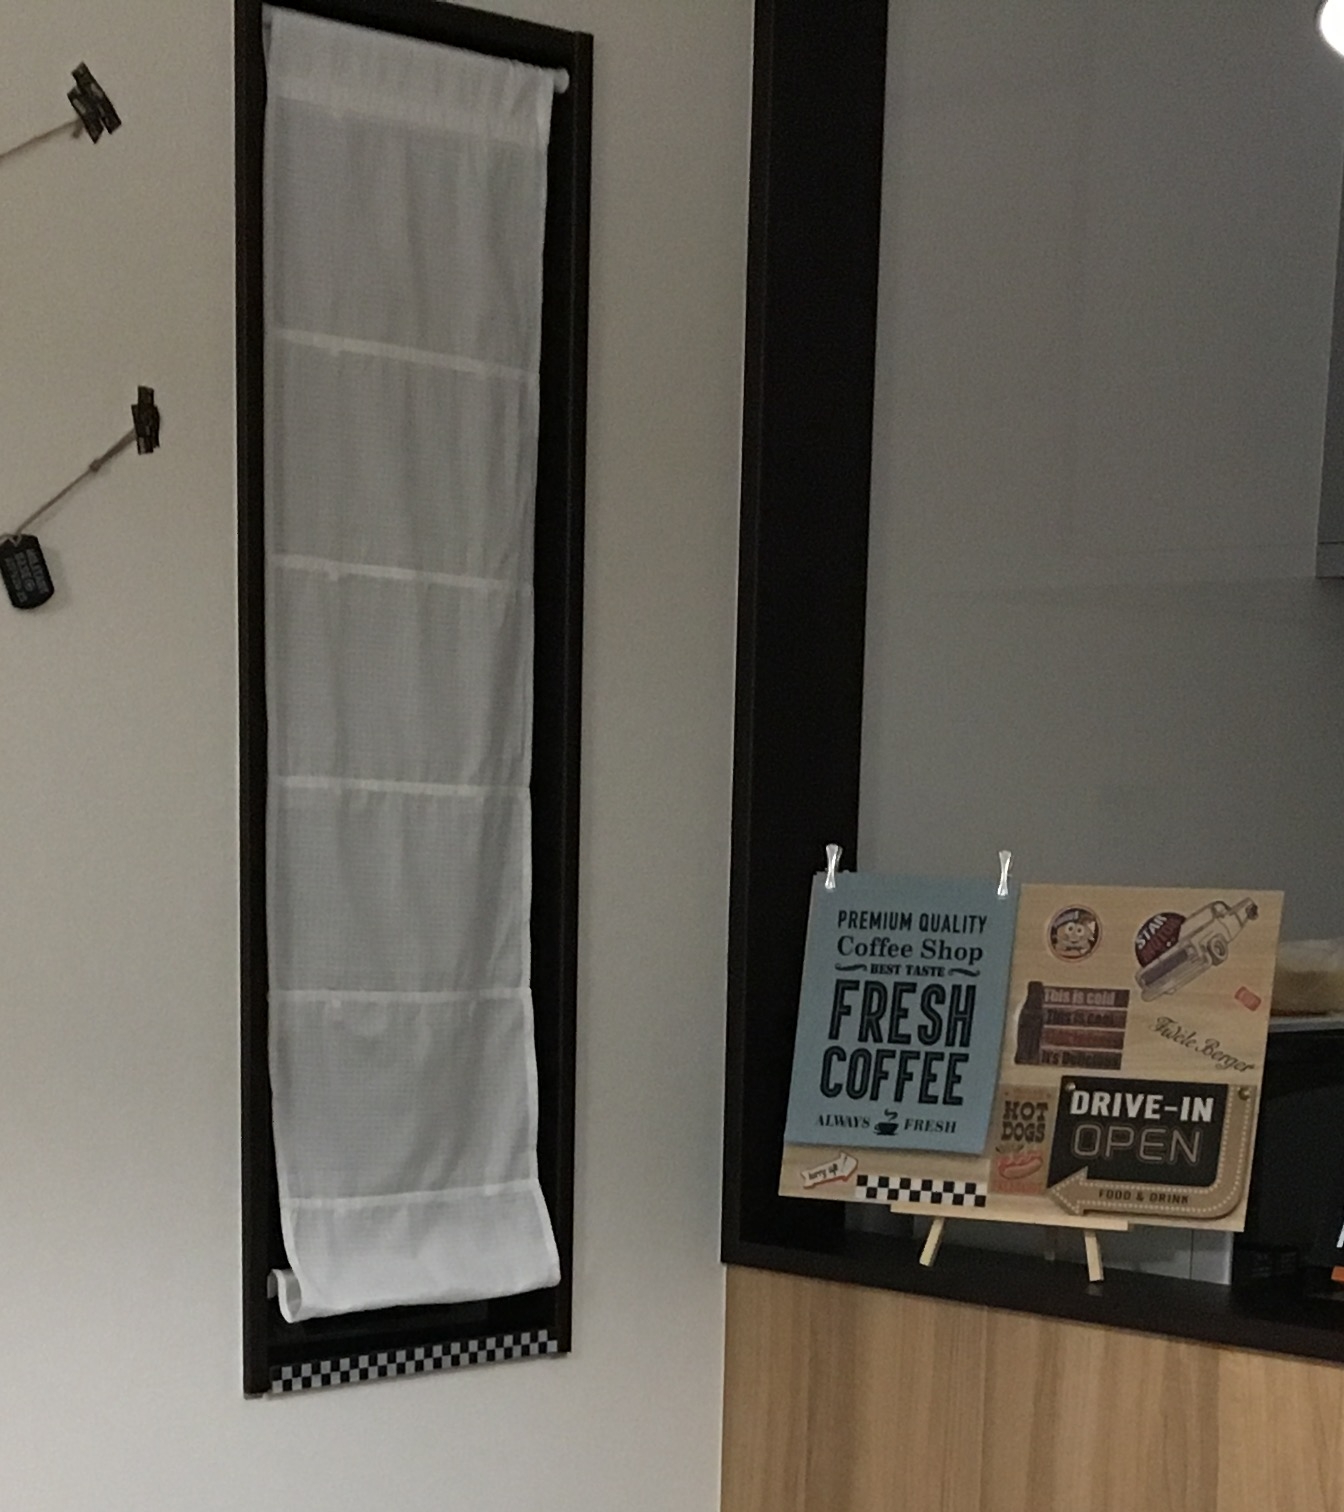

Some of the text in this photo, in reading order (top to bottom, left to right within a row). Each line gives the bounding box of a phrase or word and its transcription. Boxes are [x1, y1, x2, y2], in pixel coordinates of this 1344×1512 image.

[838, 910, 988, 934] PREMIUM QUALITY
[837, 935, 983, 965] Coffee Shop
[870, 964, 945, 977] BEST TASTE
[828, 978, 976, 1048] FRESH
[1195, 1037, 1254, 1072] Berger
[820, 1045, 969, 1106] COFFEE
[1003, 1100, 1048, 1121] HOT
[1070, 1090, 1214, 1123] DRIVE-IN
[817, 1114, 957, 1134] ALWAYS FRESH
[1001, 1120, 1046, 1143] DOGS
[1073, 1123, 1202, 1165] OPEN
[1099, 1190, 1189, 1204] FOOD DRINK
